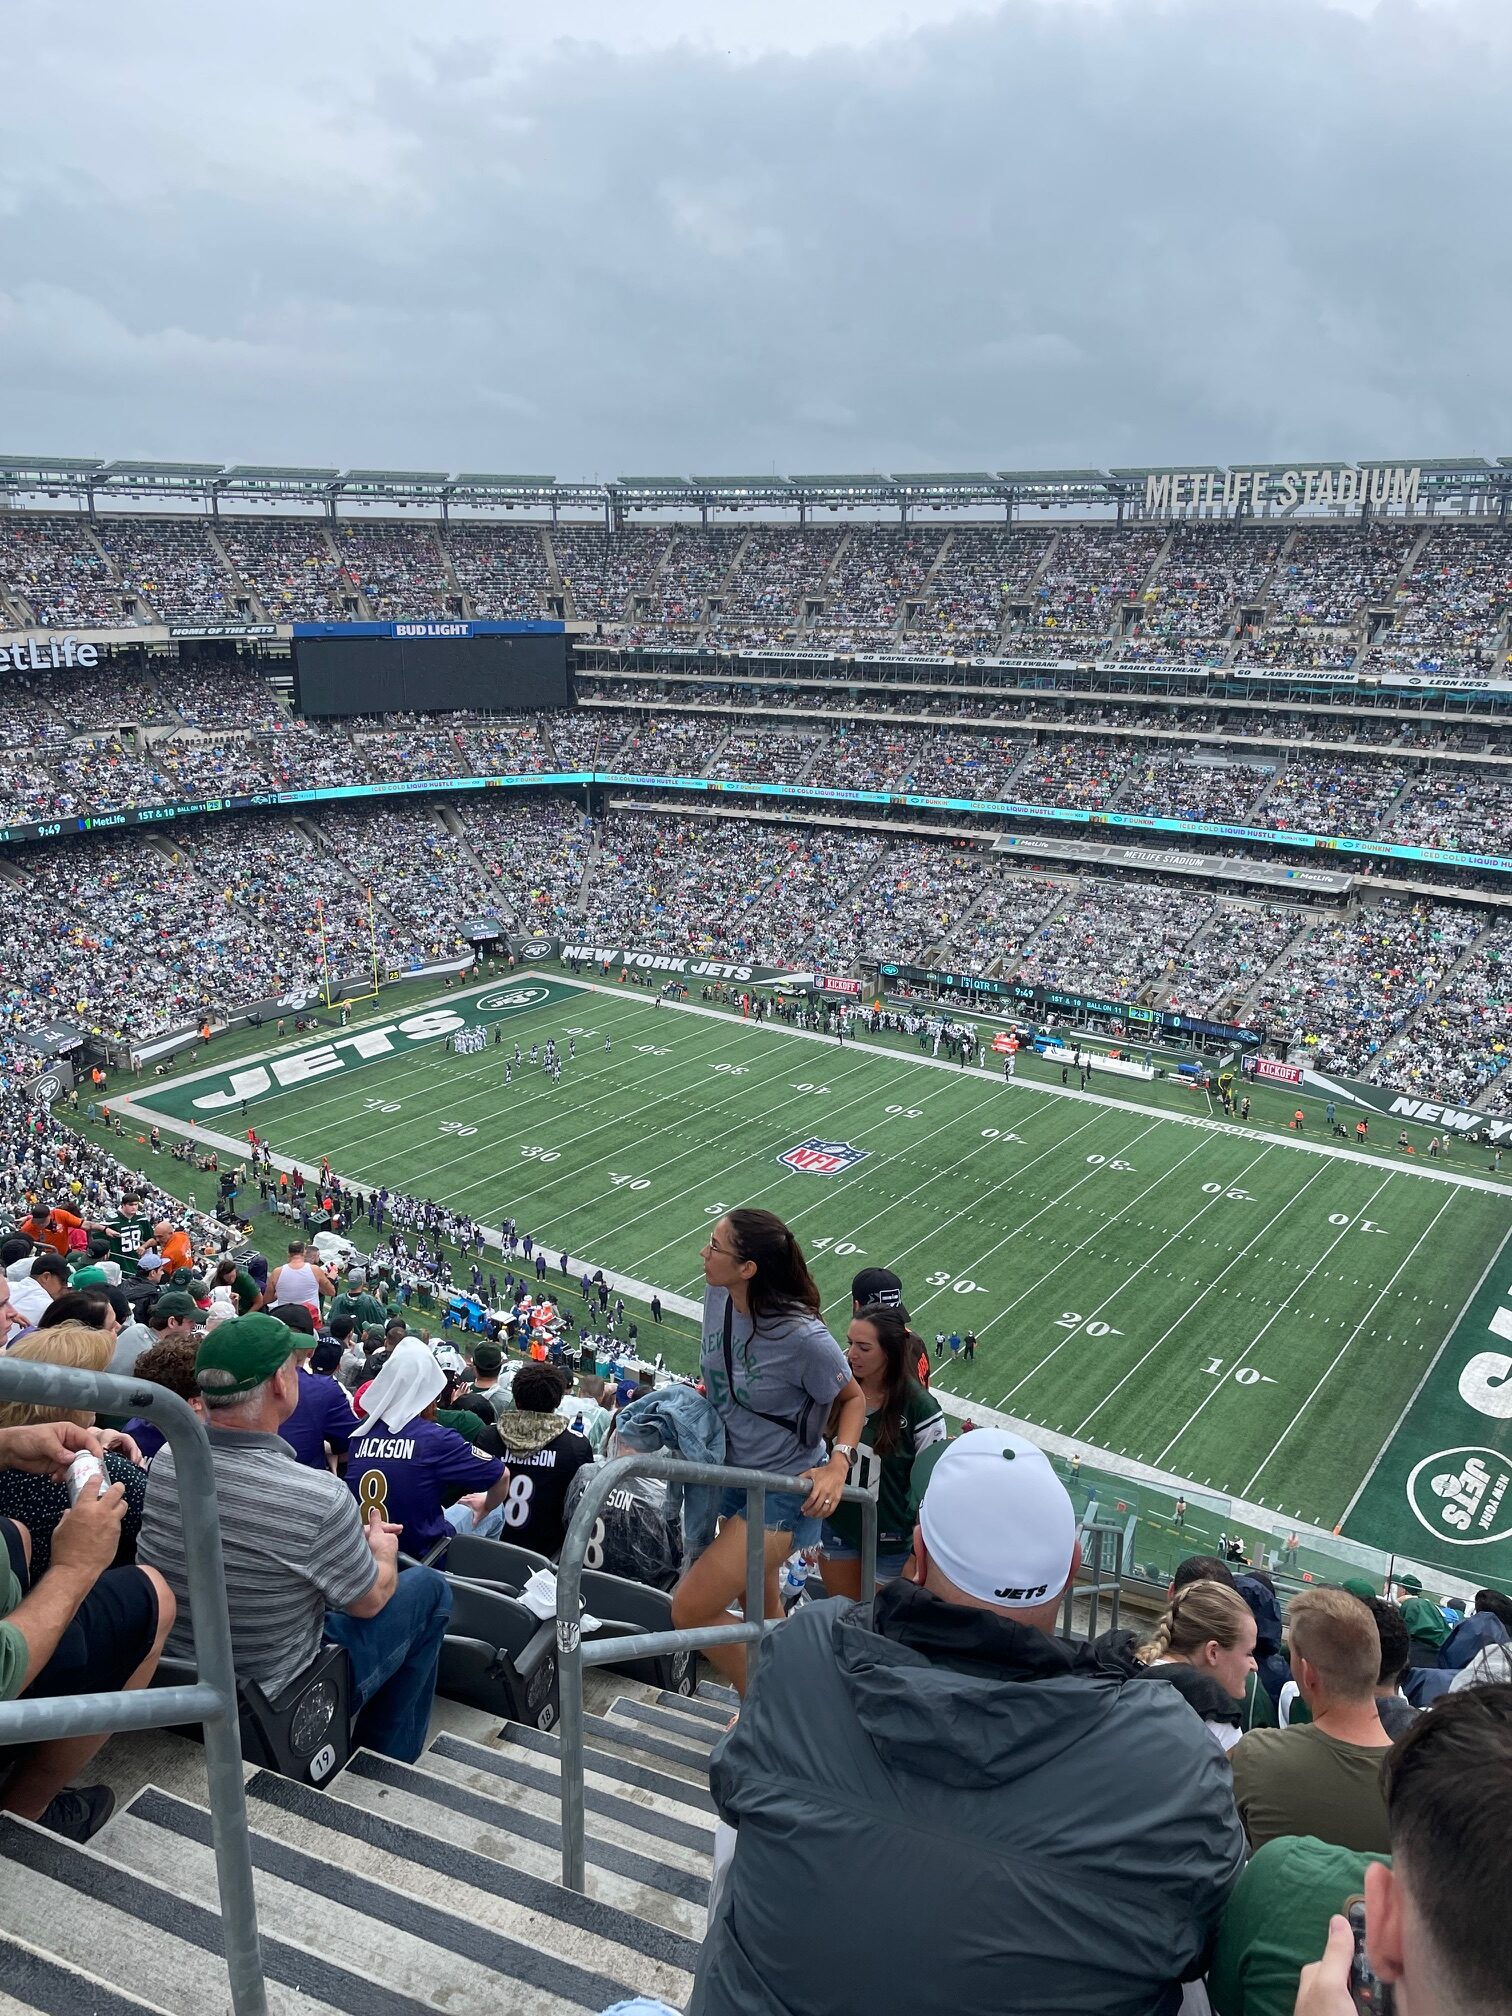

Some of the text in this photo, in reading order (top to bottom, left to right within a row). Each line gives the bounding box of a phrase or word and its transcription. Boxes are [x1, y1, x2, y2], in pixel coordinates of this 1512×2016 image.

[1145, 468, 1421, 508] METLIFE STADIUM
[172, 628, 206, 636] HOME
[247, 626, 274, 634] JETS
[396, 624, 468, 636] BUD LIGHT
[1262, 670, 1295, 678] LARRY
[1297, 671, 1355, 681] GRANTHAM
[1460, 680, 1490, 688] HESS
[836, 791, 860, 799] HUSTLE
[138, 808, 175, 821] 1ST & 10
[986, 803, 1005, 811] COLD
[1006, 805, 1029, 813] LIQUID
[1030, 808, 1056, 816] HUSTLE
[93, 815, 126, 827] MetLife
[38, 824, 61, 837] 9:49
[1220, 827, 1246, 836] LIQUID
[1247, 830, 1277, 839] HUSTLE
[1021, 840, 1049, 848] MetLife
[1123, 851, 1204, 867] METLIFE STADIUM
[1421, 851, 1440, 859] ICED
[1443, 854, 1467, 862] COLD
[1469, 857, 1499, 867] LIQUID
[1300, 873, 1334, 882] MetLife
[563, 945, 752, 981] NEW YORK JETS
[389, 972, 399, 980] 25
[947, 976, 953, 985] 0
[827, 979, 855, 991] KICKOFF
[974, 981, 990, 990] QTR
[1015, 988, 1034, 998] 9:49
[277, 987, 319, 1007] JETS
[1086, 1001, 1122, 1014] BALL ON 11
[1173, 1017, 1180, 1027] 0
[264, 1048, 283, 1056] IT
[290, 1028, 344, 1047] TAKES
[350, 1017, 380, 1030] ALL
[191, 1009, 466, 1109] JETS
[1259, 1062, 1297, 1080] KICKOFF
[364, 1098, 402, 1113] 10
[1388, 1096, 1484, 1131] NEW
[438, 1121, 479, 1138] 20
[1182, 1117, 1268, 1139] KICKOFF
[521, 1146, 561, 1163] 30
[785, 1148, 844, 1172] NFL
[609, 1172, 652, 1191] 40
[704, 1202, 729, 1215] 5
[811, 1236, 856, 1256] 40
[926, 1271, 976, 1295] 30
[1054, 1312, 1112, 1338] 20
[1199, 1357, 1261, 1386] 10
[355, 1438, 415, 1460] JACKSON
[359, 1469, 389, 1526] 8
[504, 1474, 533, 1527] 8
[1441, 1457, 1491, 1531] JETS
[1478, 1473, 1510, 1531] NEW YORK
[583, 1517, 605, 1569] 8
[994, 1584, 1048, 1600] JETS
[542, 1709, 552, 1726] 18
[316, 1751, 331, 1774] 19
